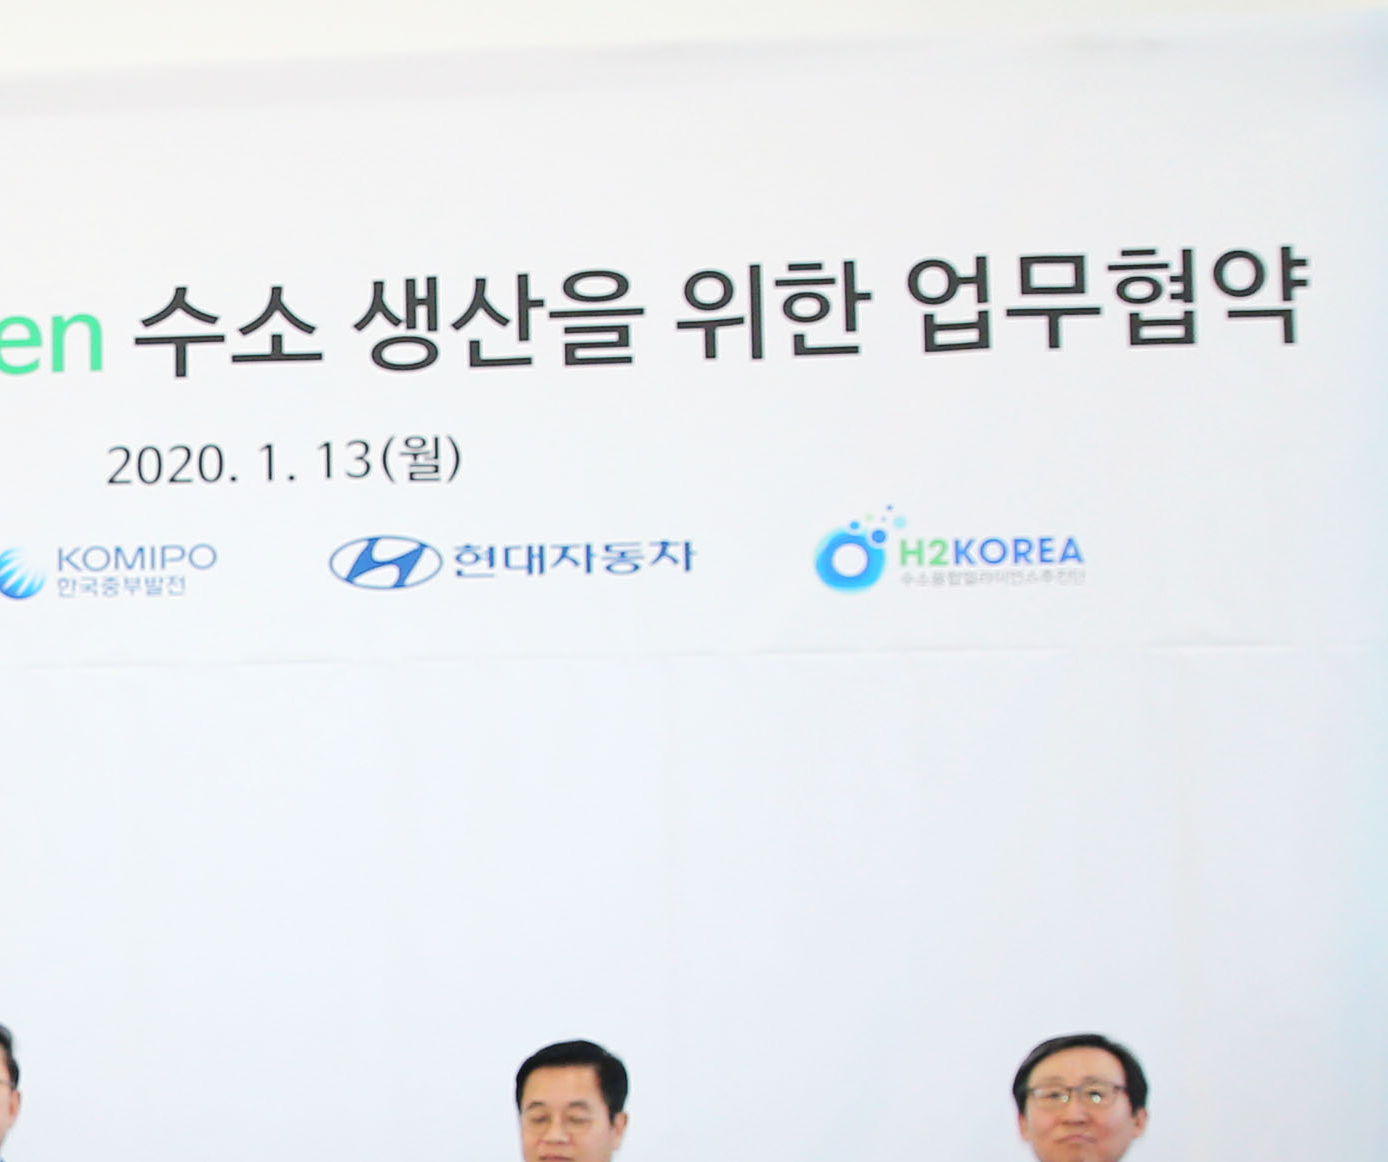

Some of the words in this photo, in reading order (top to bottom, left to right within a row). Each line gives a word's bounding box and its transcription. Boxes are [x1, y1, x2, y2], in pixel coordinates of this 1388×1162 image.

[132, 284, 325, 380] 수소
[351, 268, 647, 373] 생산을
[674, 258, 875, 362] 위한
[905, 244, 1312, 355] 업무협약
[105, 443, 239, 486] 2020.
[260, 443, 296, 482] 1.
[318, 433, 463, 484] 13(월)
[56, 542, 218, 573] KOMIPO
[453, 538, 697, 579] 현대자동차
[899, 536, 1086, 567] H2KOREA
[56, 574, 187, 598] 한국중부발전
